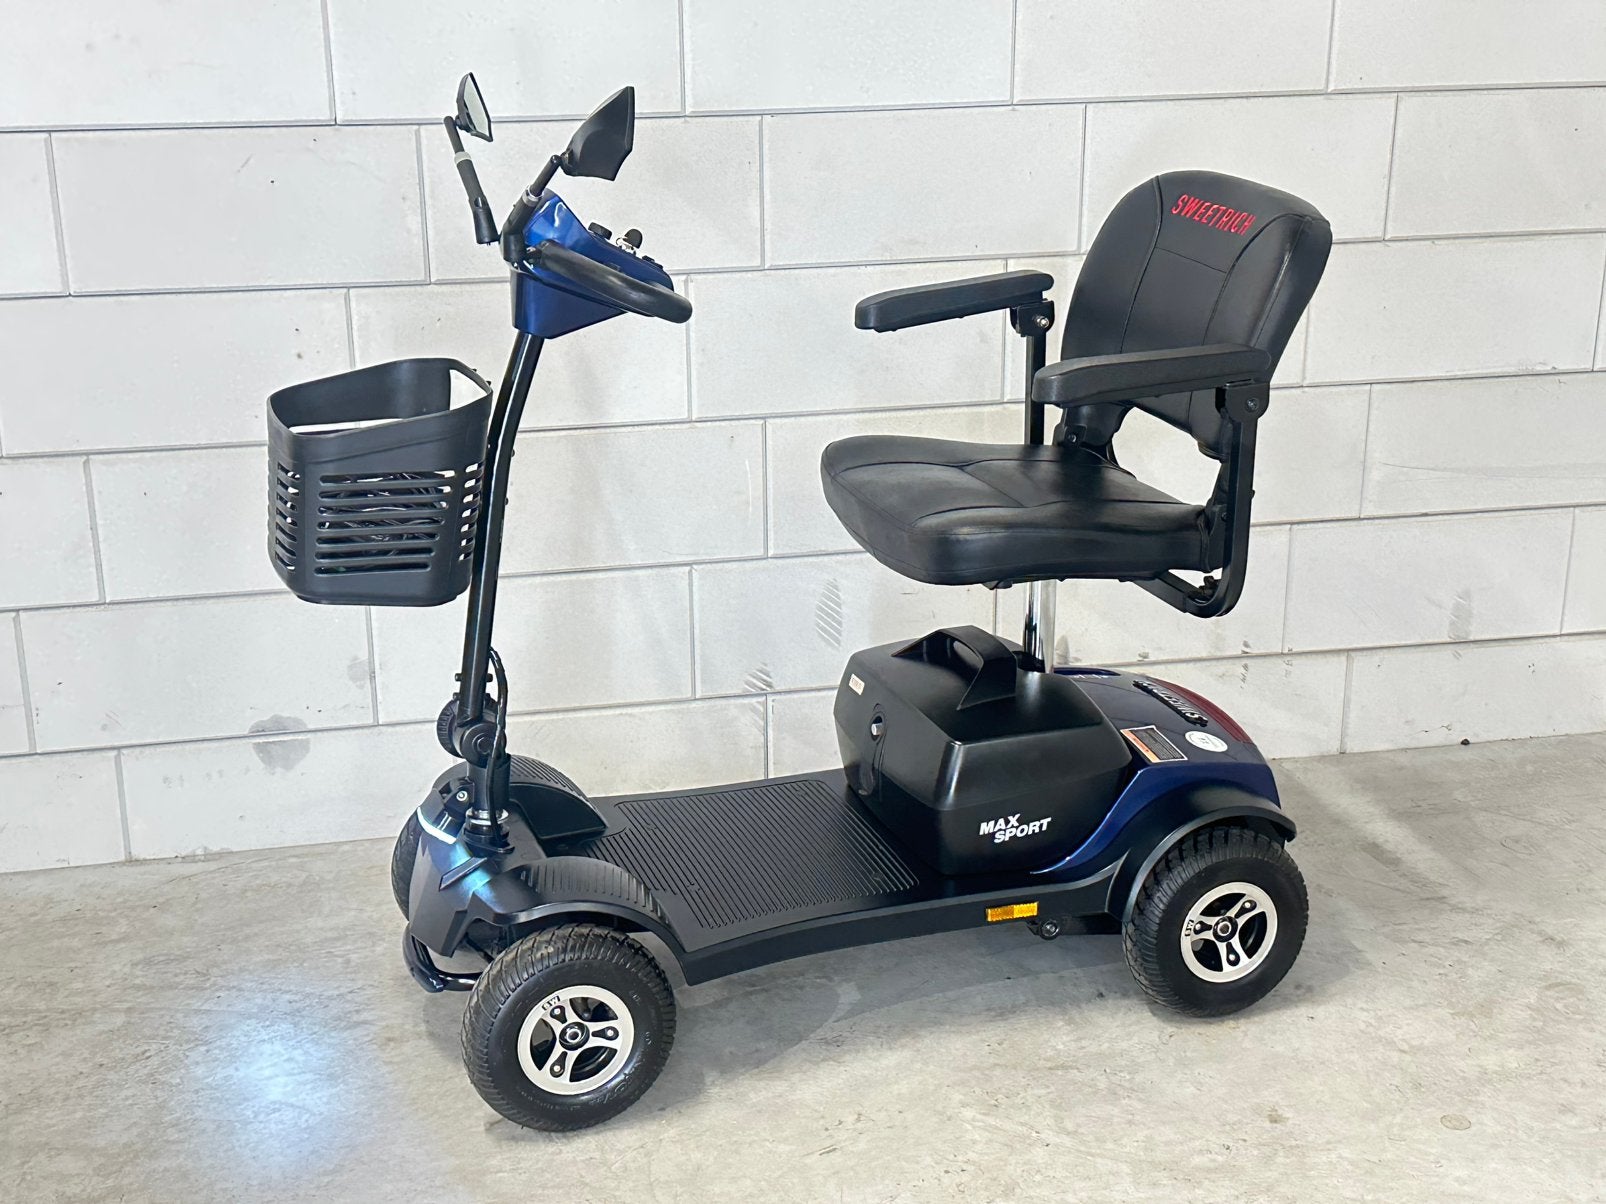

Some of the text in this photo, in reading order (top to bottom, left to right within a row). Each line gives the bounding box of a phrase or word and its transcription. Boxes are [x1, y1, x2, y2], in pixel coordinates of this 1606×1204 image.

[1171, 194, 1256, 236] SWEETRICH
[979, 813, 1021, 835] MAX
[993, 817, 1052, 843] SPORT
